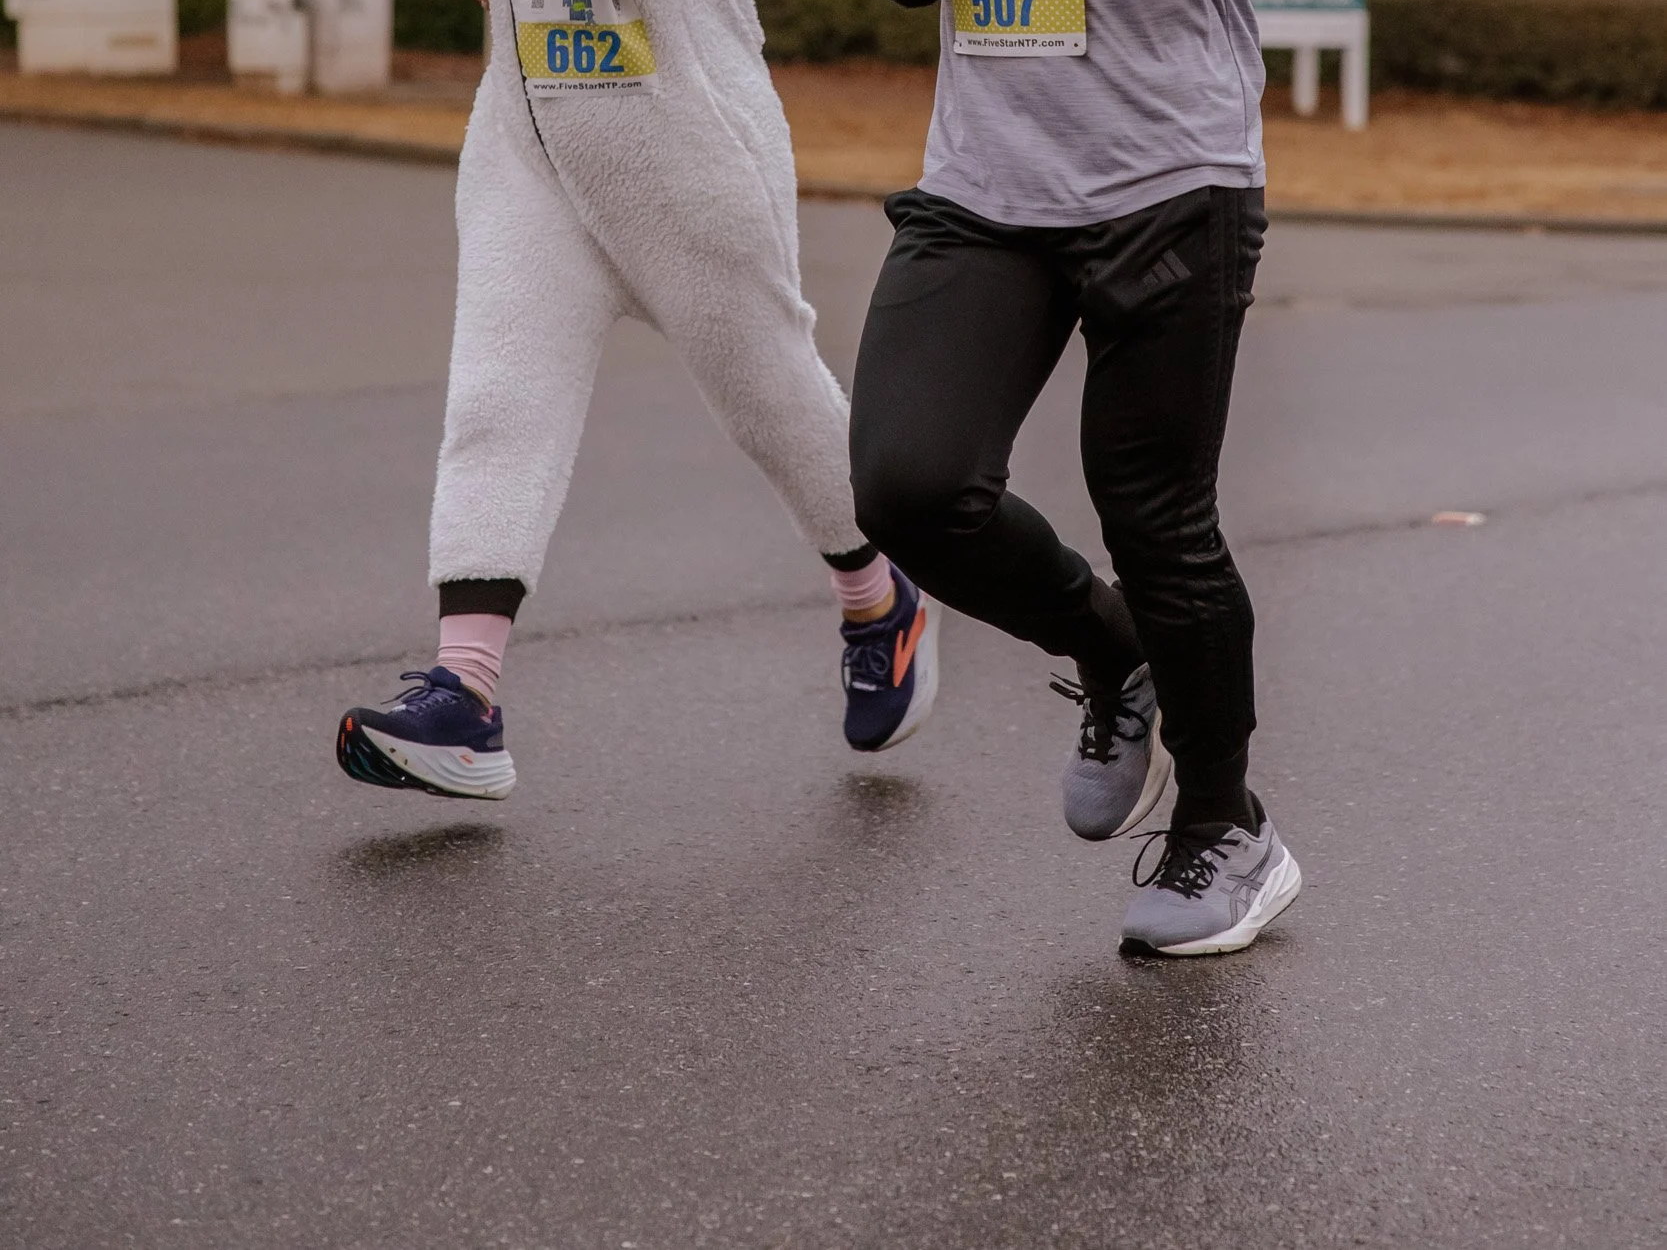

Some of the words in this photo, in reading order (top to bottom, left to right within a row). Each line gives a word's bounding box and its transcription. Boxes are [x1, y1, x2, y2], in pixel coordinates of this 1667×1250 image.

[967, 38, 1065, 48] www.FiveStarNTP.com
[547, 29, 624, 73] 662
[533, 80, 642, 90] www.FiveStarNTP.com
